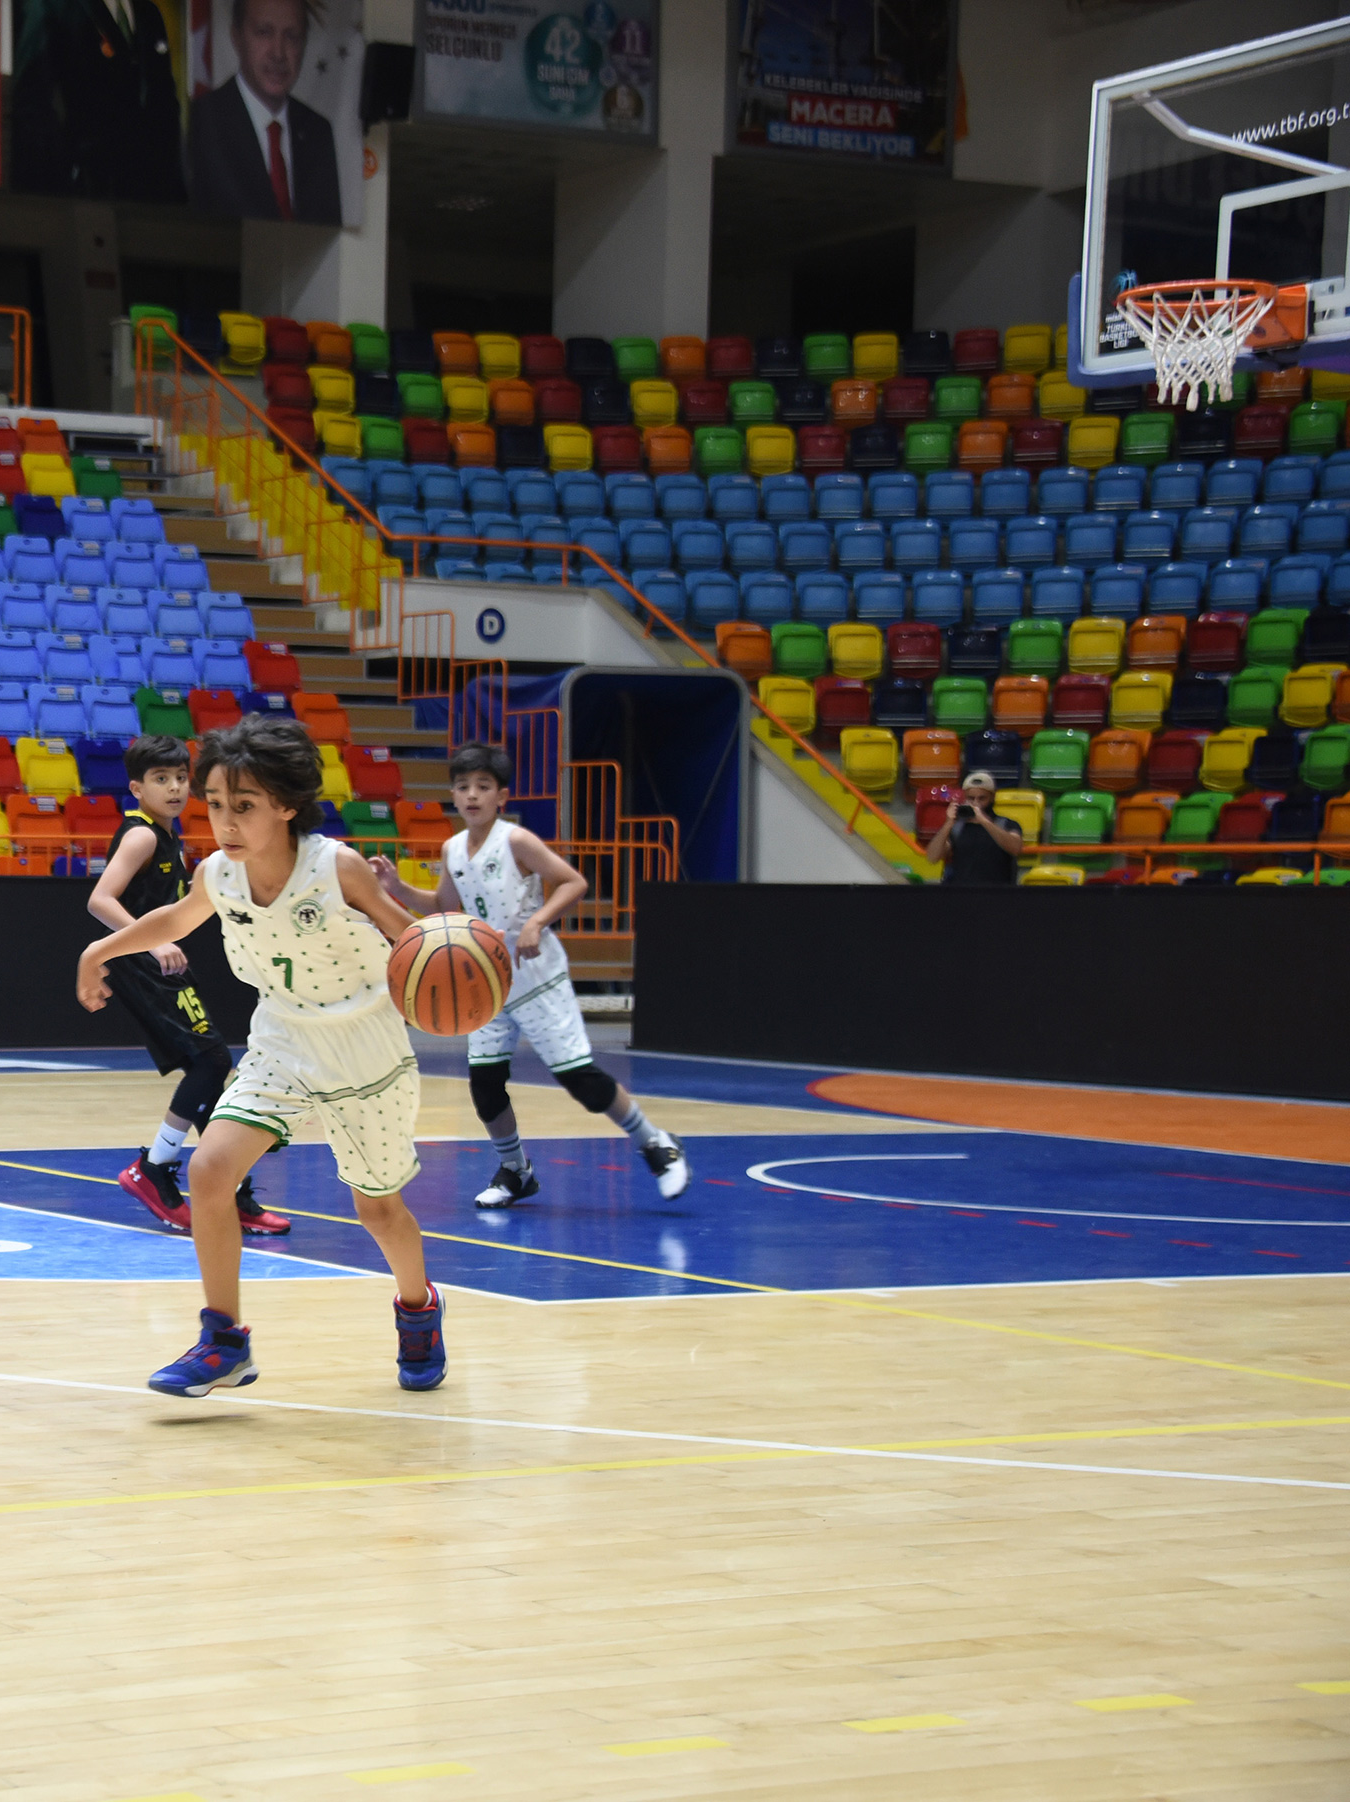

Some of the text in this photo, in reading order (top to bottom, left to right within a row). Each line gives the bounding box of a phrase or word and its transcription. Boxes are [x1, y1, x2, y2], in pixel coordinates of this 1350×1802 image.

[544, 26, 581, 65] 42
[790, 98, 896, 128] MACERA
[483, 615, 499, 636] D
[475, 896, 488, 919] 8
[271, 957, 293, 990] 7
[176, 986, 207, 1024] 15
